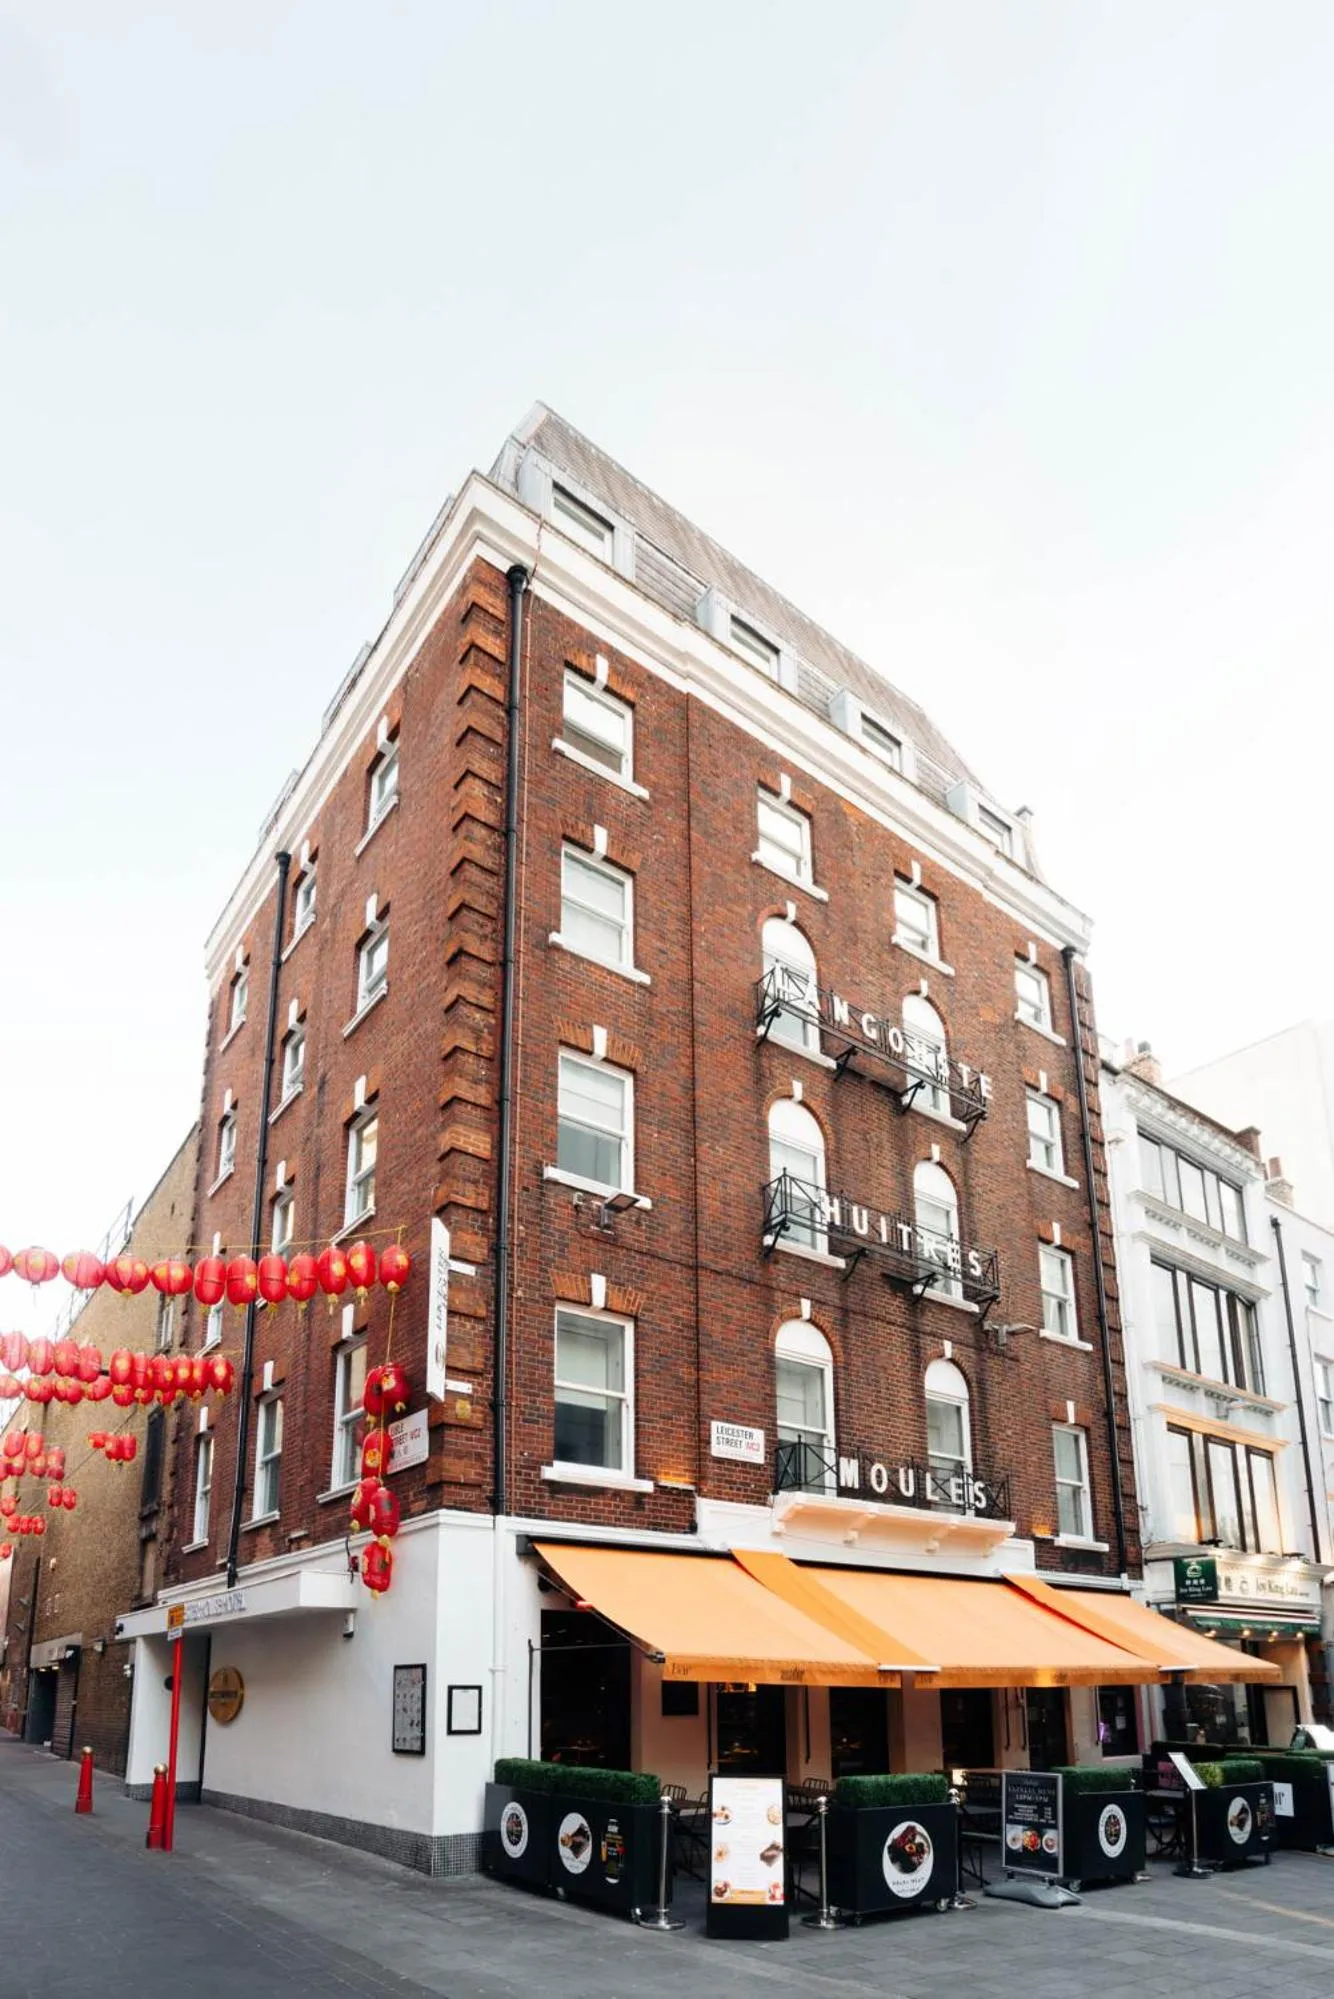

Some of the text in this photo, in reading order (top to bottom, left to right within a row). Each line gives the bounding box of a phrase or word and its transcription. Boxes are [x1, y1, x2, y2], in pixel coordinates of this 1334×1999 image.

[716, 1425, 754, 1441] LEICESTER
[716, 1436, 743, 1449] STREET
[839, 1456, 987, 1509] MOULES
